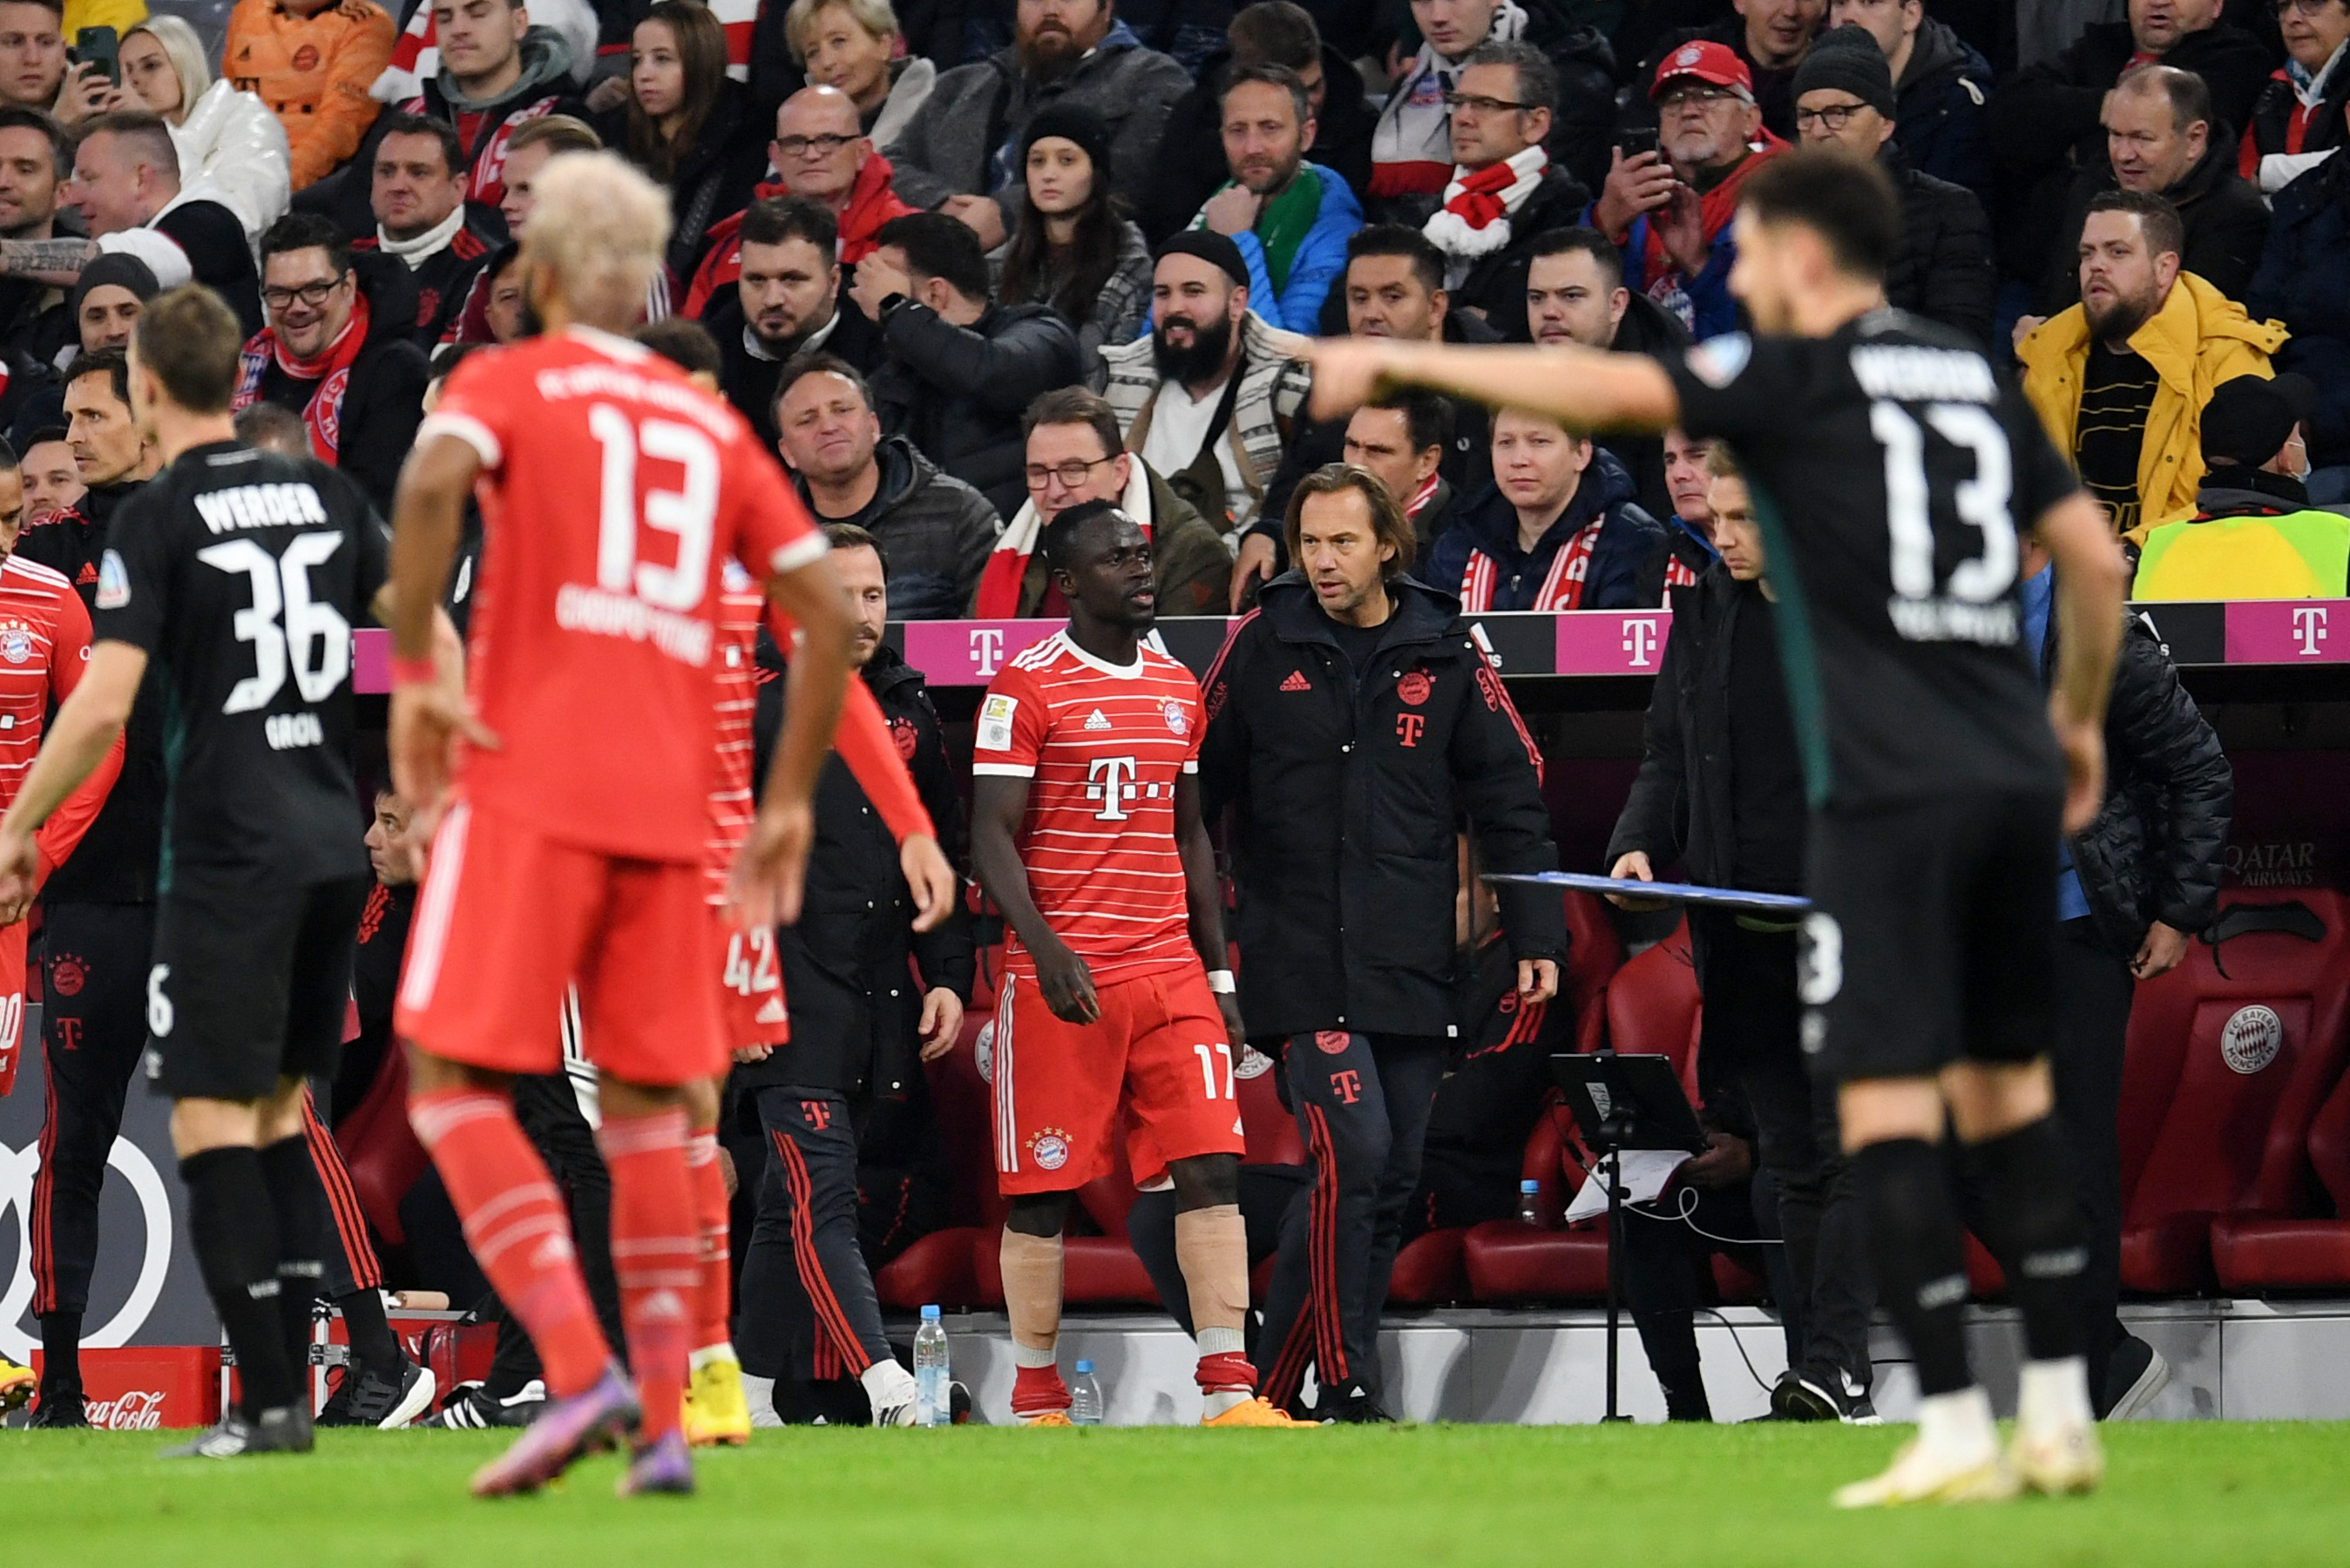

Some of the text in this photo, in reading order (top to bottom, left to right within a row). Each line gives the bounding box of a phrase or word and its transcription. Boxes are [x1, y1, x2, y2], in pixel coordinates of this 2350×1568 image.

[193, 483, 328, 535] WERDER
[587, 401, 721, 611] 13
[1869, 396, 2019, 604] 13
[76, 576, 99, 585] adida
[195, 530, 351, 715] 36
[1622, 618, 1656, 666] T
[2293, 607, 2327, 655] T
[970, 629, 1004, 676] T
[1279, 682, 1311, 692] adidas
[1084, 721, 1112, 730] adidas
[1396, 713, 1426, 747] T
[2225, 842, 2314, 875] QATAR
[2242, 869, 2313, 887] AIRWAYS
[722, 925, 780, 997] 42
[2228, 1010, 2276, 1036] FC BAYERN
[1330, 1069, 1361, 1105] T
[85, 1391, 166, 1430] ca-Cola
